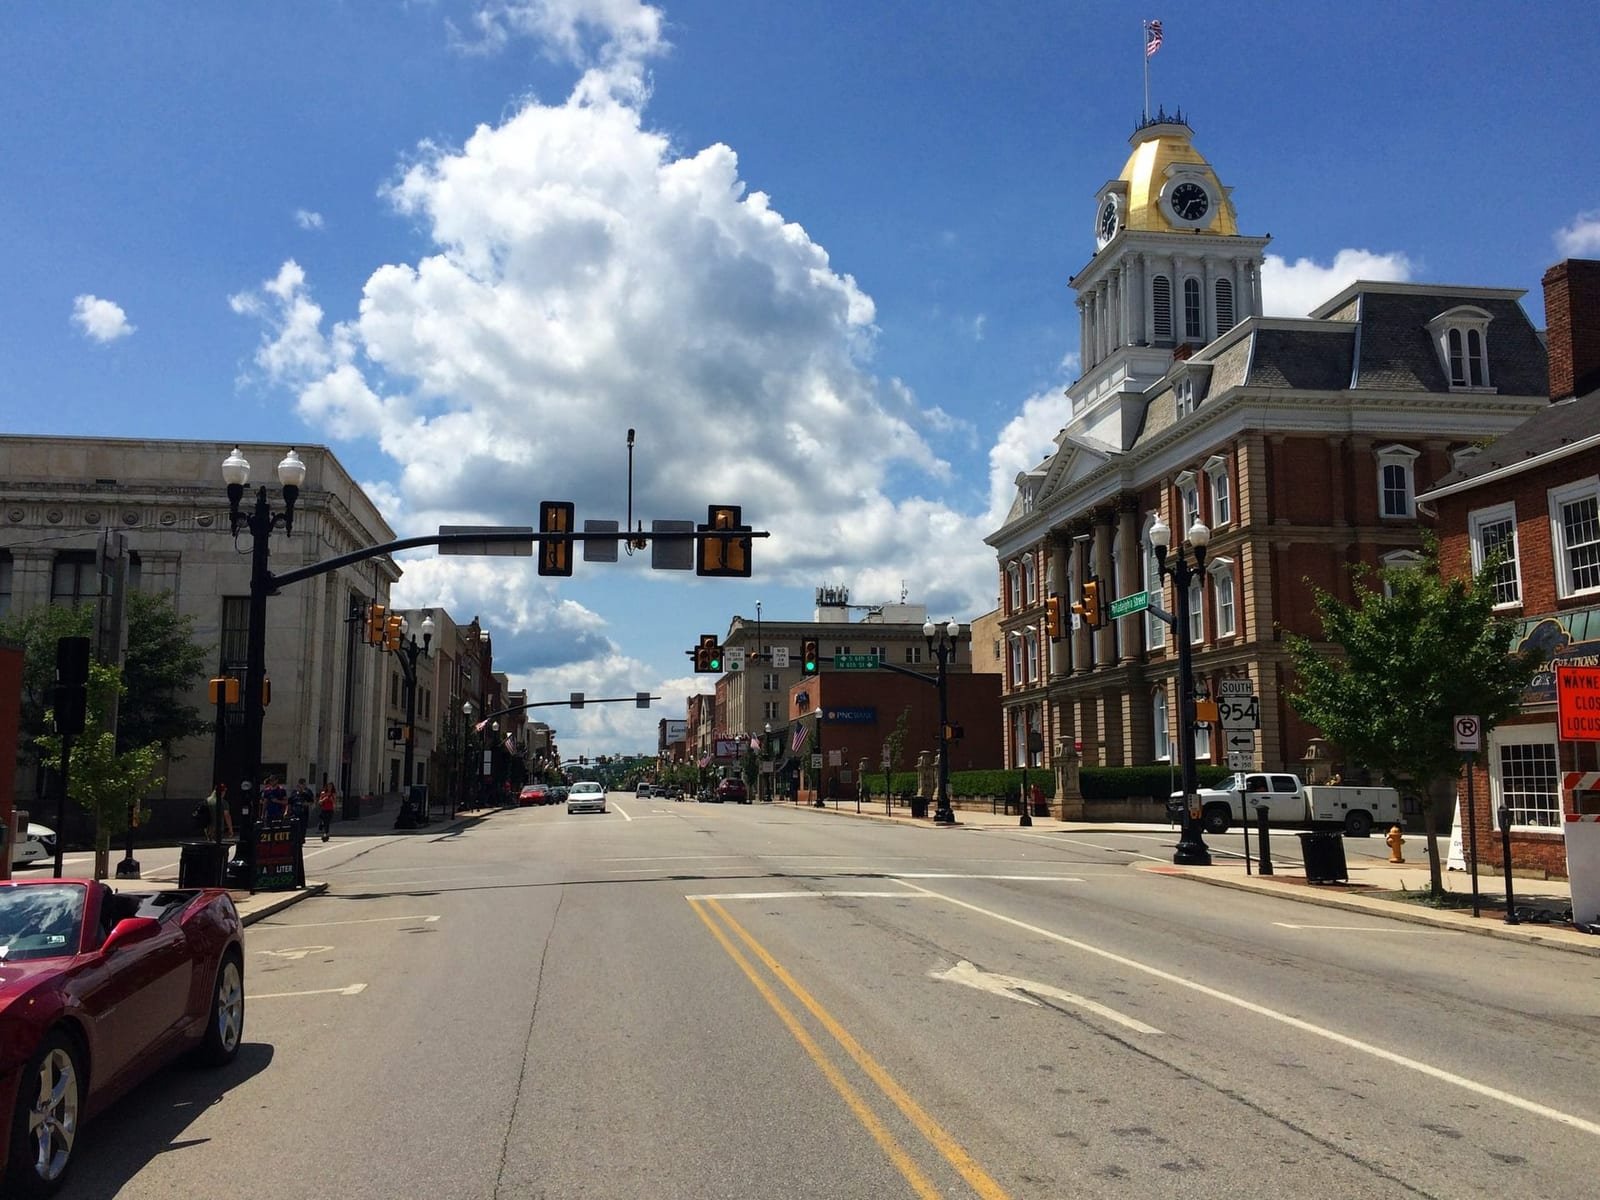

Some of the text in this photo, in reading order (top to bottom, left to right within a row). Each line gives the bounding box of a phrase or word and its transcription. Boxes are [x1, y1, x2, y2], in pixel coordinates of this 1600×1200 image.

[1222, 682, 1252, 693] SOUTH
[1563, 675, 1600, 689] WAYNE
[1219, 703, 1257, 721] 954
[276, 865, 293, 873] LITER
